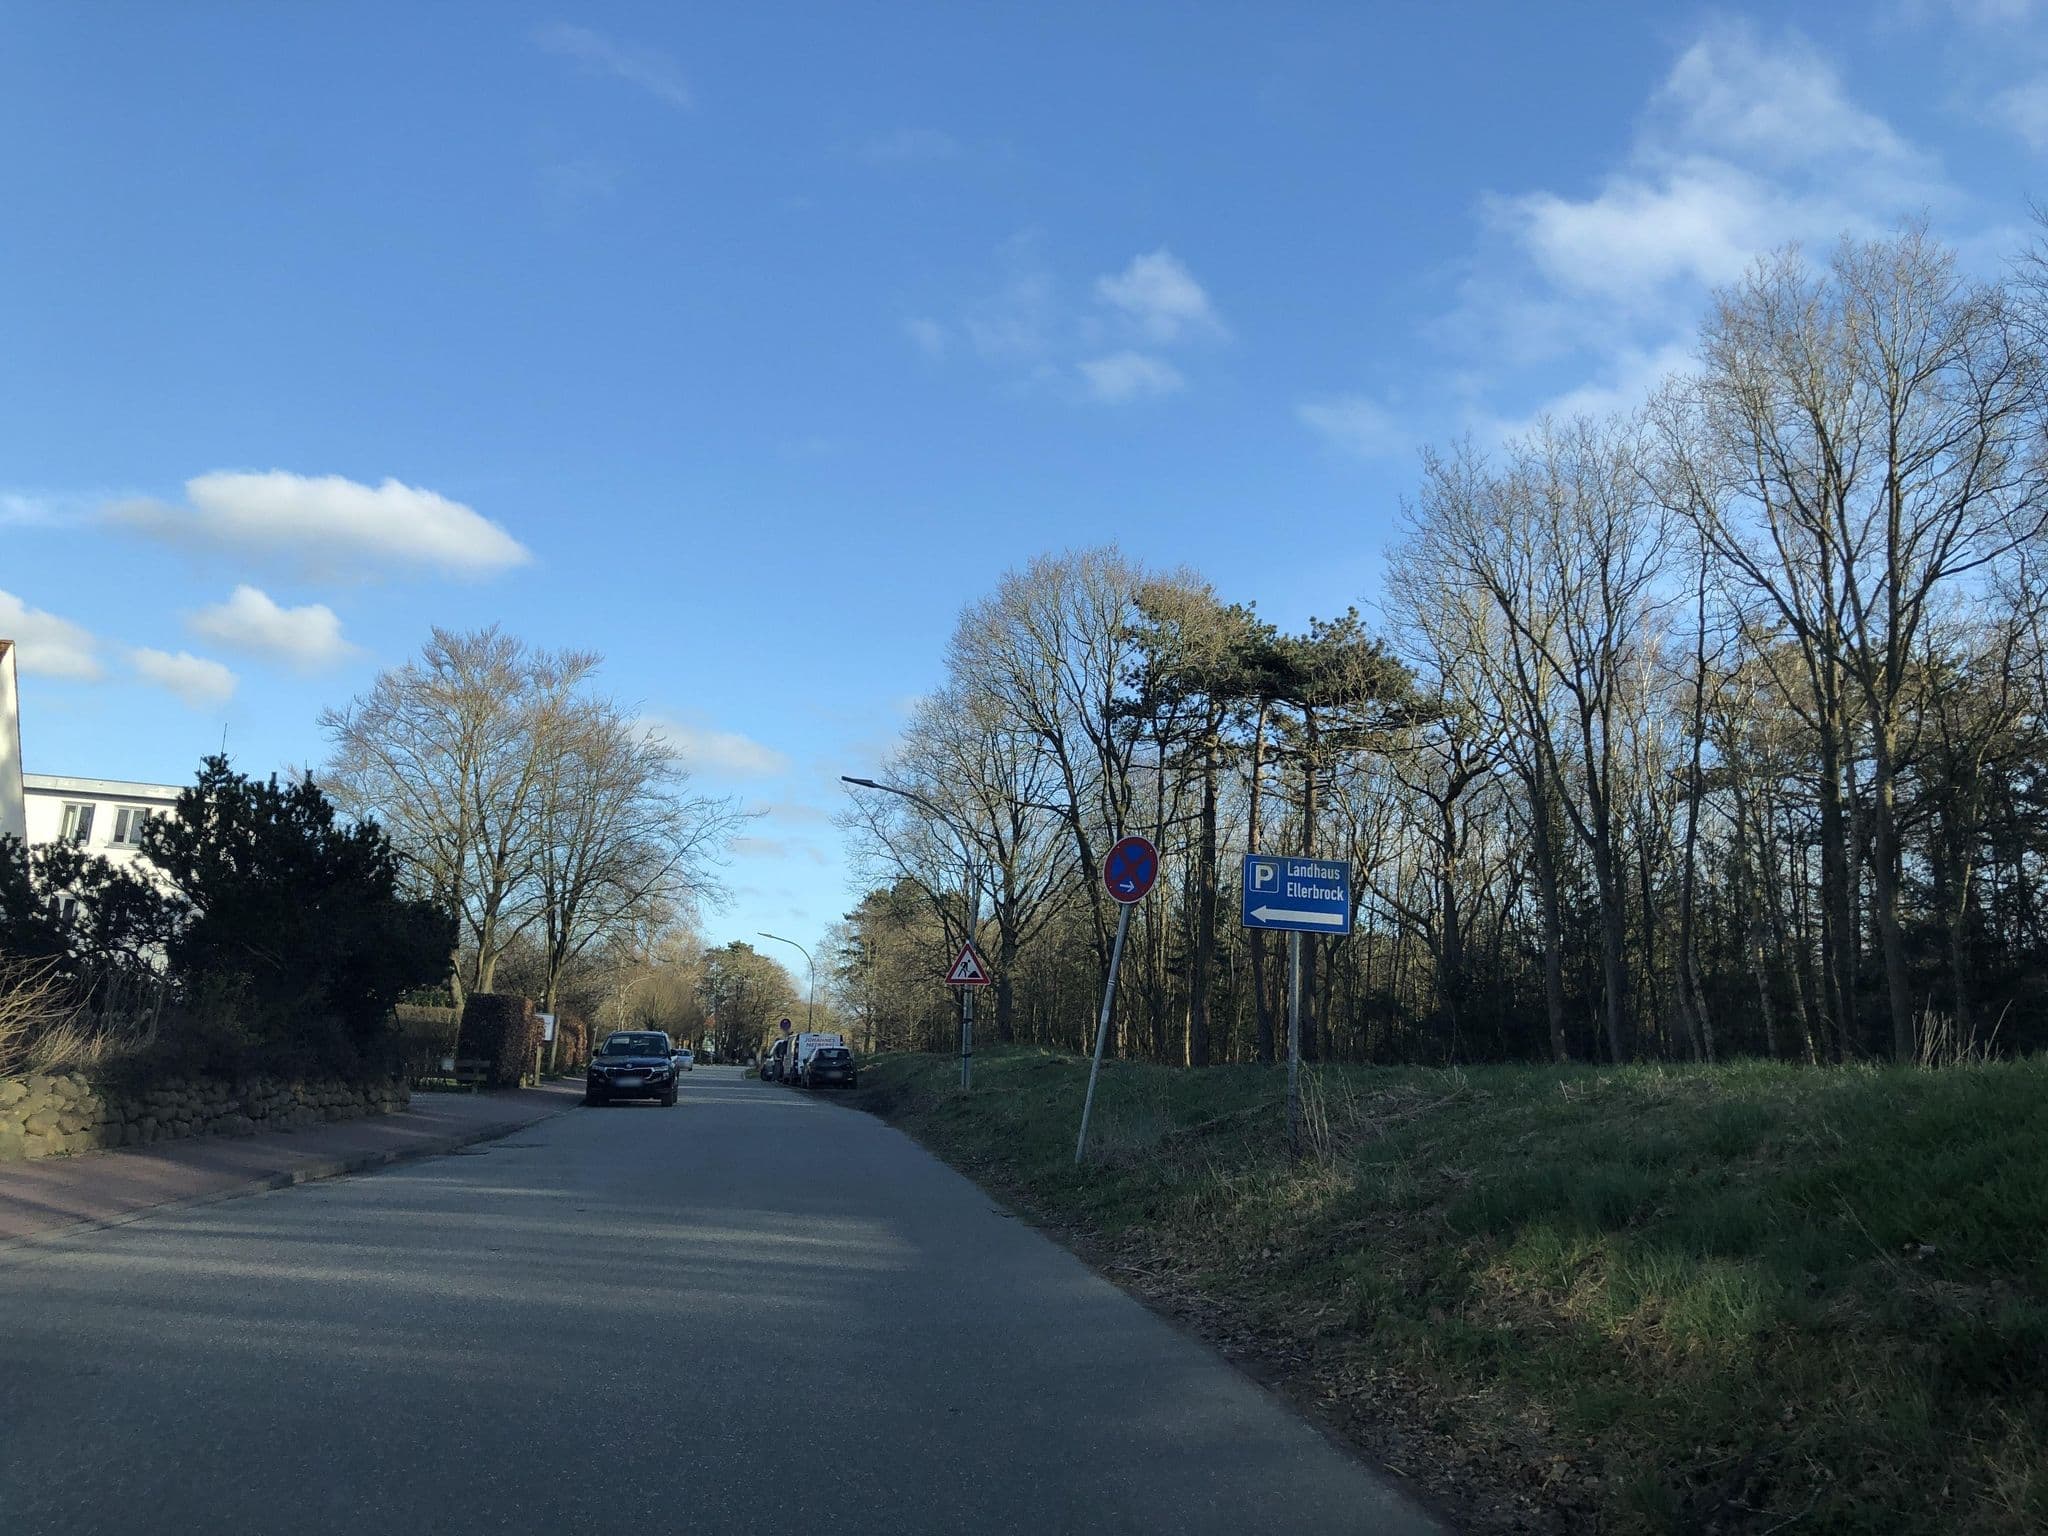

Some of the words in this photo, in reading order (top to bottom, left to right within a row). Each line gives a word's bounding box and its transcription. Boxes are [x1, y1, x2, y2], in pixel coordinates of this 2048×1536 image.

[1255, 864, 1274, 889] P
[1287, 861, 1341, 880] Landhaus
[1287, 882, 1345, 901] Ellerbrock
